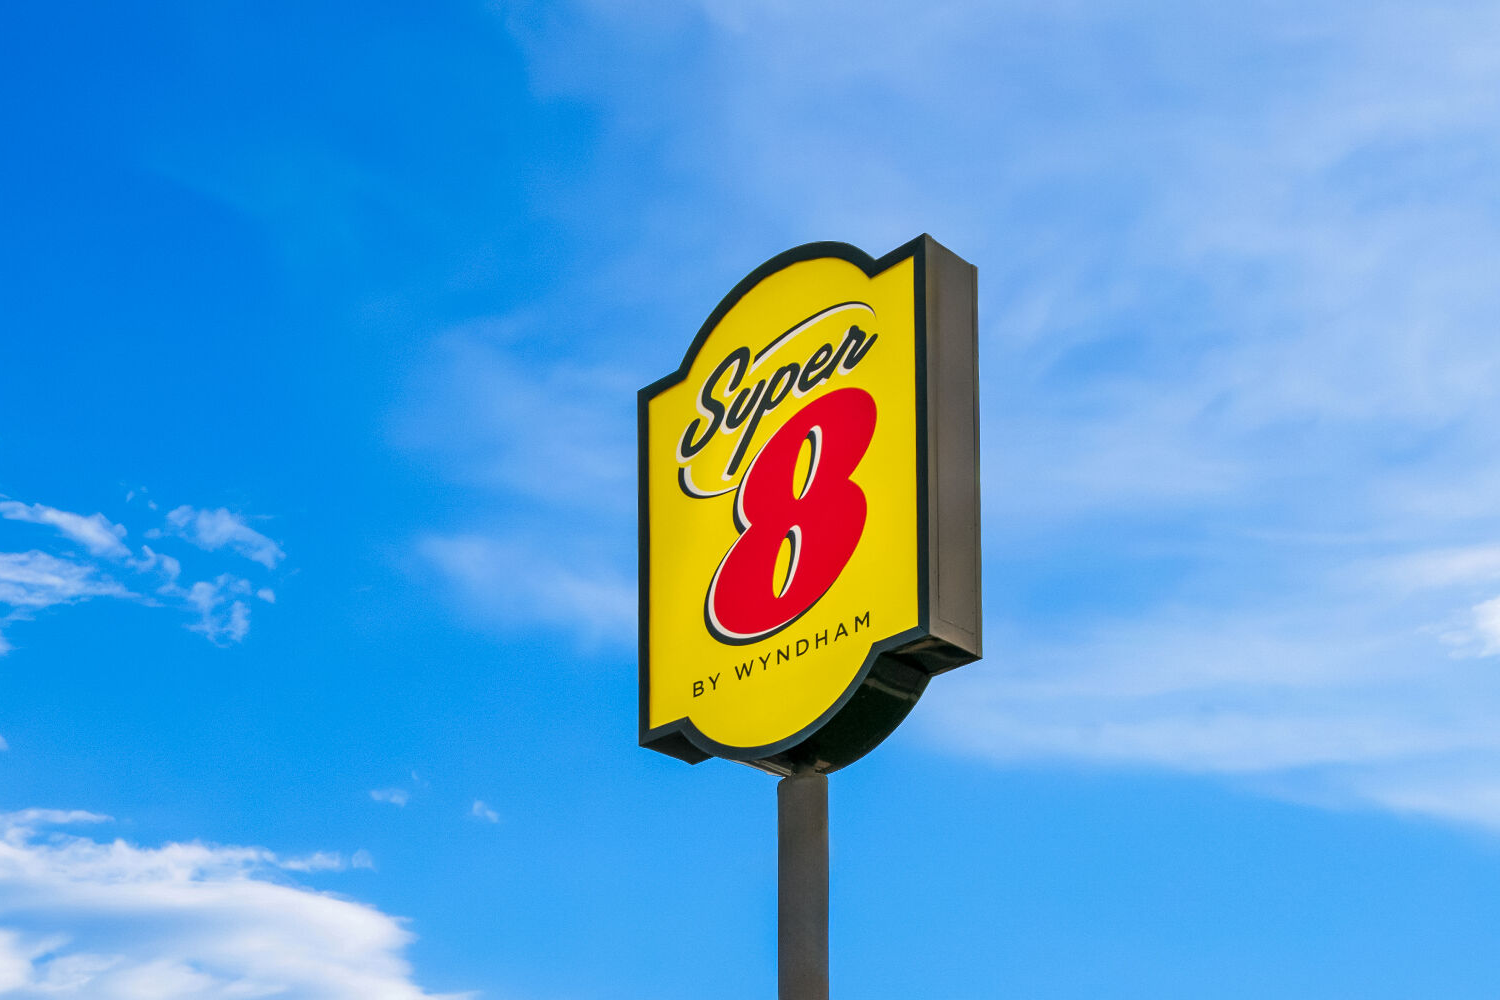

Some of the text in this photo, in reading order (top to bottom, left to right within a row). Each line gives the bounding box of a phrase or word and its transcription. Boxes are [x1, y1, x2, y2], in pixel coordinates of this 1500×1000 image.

[677, 325, 878, 480] Super
[704, 387, 877, 646] 8
[693, 611, 870, 697] BY WYNDHAM
